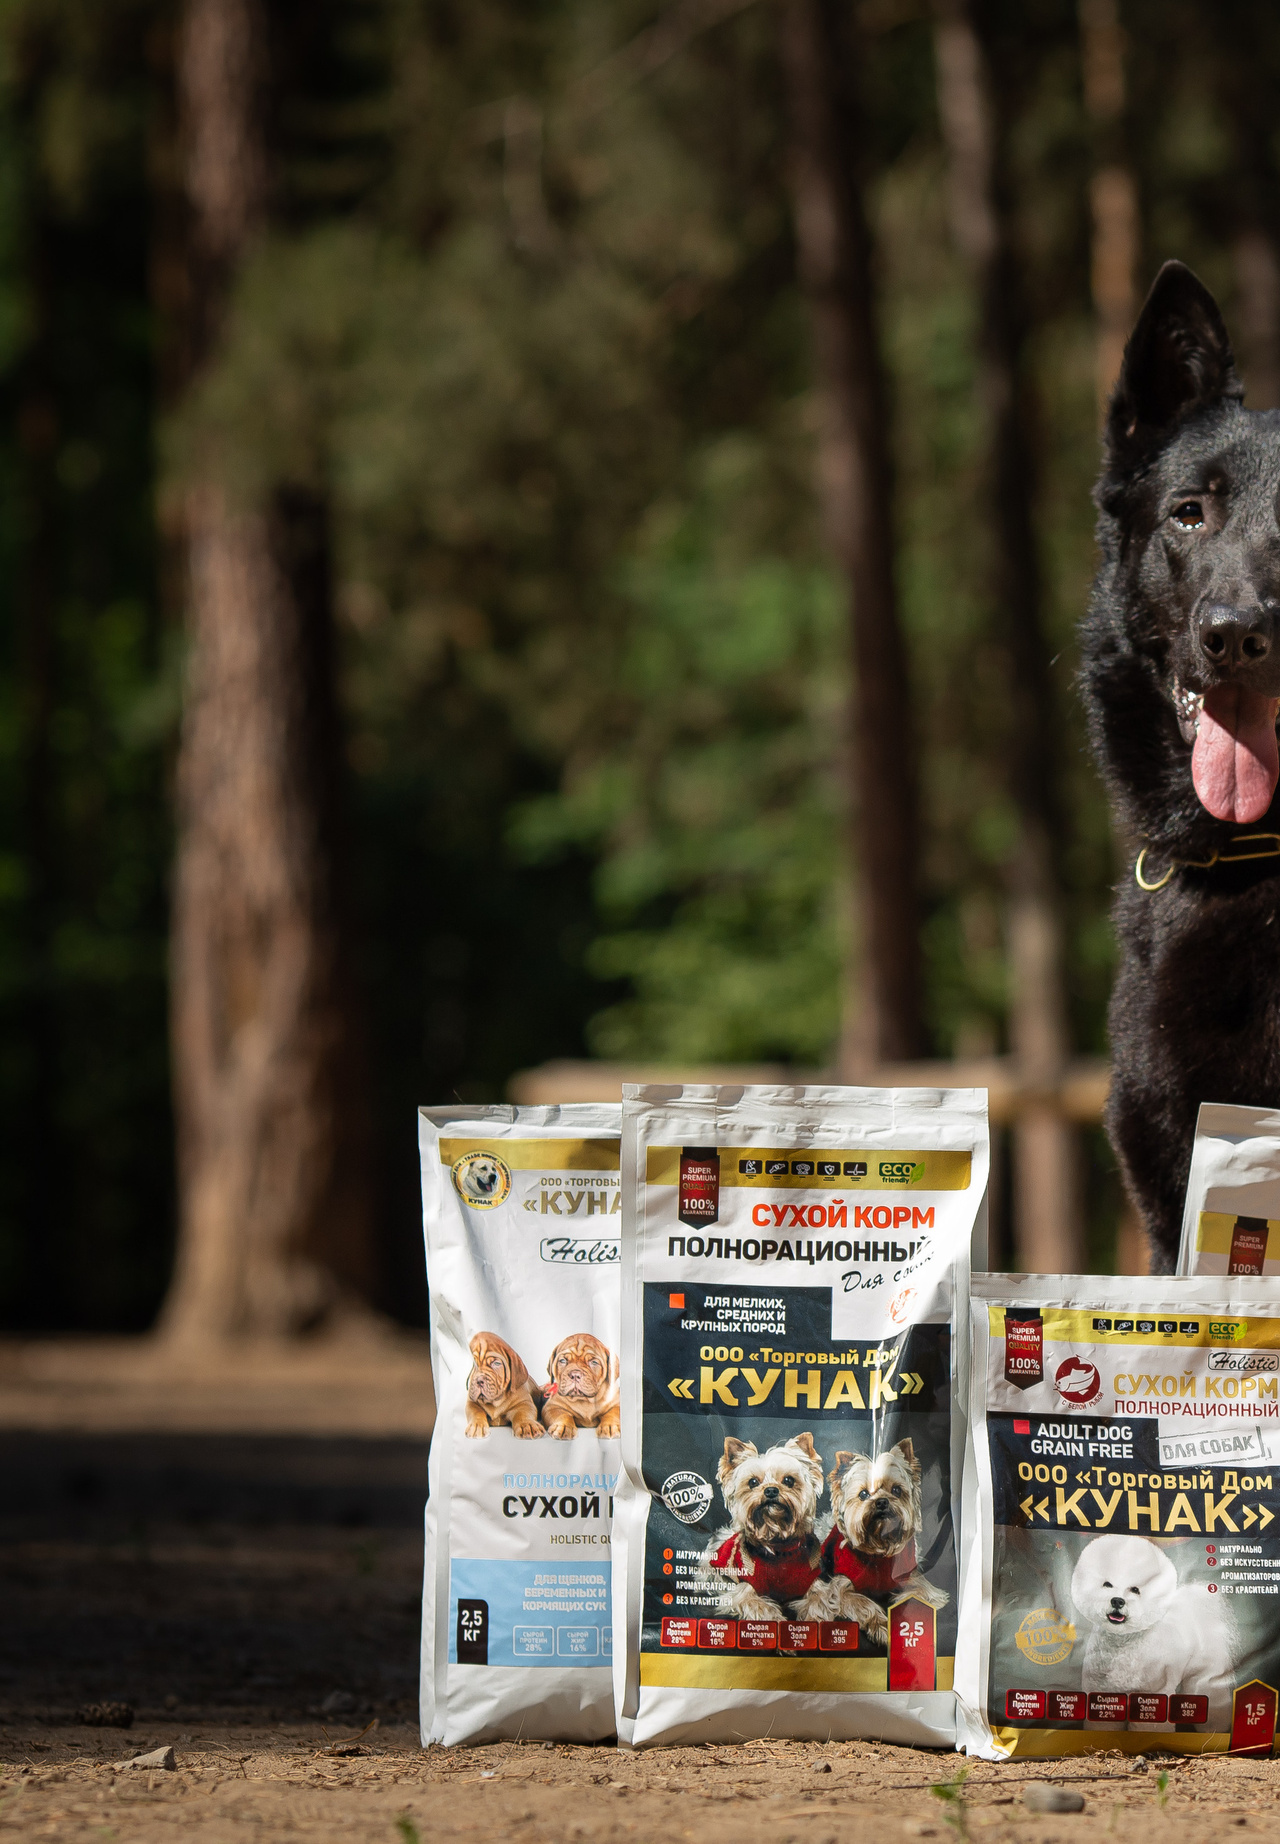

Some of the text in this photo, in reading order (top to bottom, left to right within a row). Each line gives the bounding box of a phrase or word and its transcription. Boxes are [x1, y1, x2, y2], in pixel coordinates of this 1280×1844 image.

[687, 1166, 712, 1174] SUPER
[881, 1164, 913, 1175] eco
[540, 1178, 562, 1187] ООО
[682, 1174, 717, 1182] PREMIUM
[882, 1176, 910, 1185] friendly
[682, 1182, 716, 1191] QUALITY
[468, 1197, 493, 1206] КУНАК
[683, 1198, 715, 1210] 100%
[752, 1199, 936, 1229] СУХОЙ КОРМ
[1239, 1235, 1260, 1243] SUPER
[547, 1238, 621, 1262] Holis
[1234, 1241, 1264, 1250] PREMIUM
[1232, 1263, 1259, 1275] 100%
[841, 1270, 884, 1293] Для
[704, 1295, 786, 1311] ДЛЯ МЕЛКИХ,
[716, 1309, 786, 1322] СРЕДНИХ И
[681, 1319, 786, 1335] КРУПНЫХ ПОРОД
[1012, 1327, 1035, 1335] SUPER
[1211, 1323, 1237, 1334] eco
[1007, 1333, 1040, 1342] PREMIUM
[1008, 1341, 1040, 1351] QUALITY
[700, 1345, 899, 1368] ООО «Торговый Дом
[1212, 1351, 1277, 1371] Holistic
[1009, 1357, 1040, 1370] 100%
[667, 1366, 925, 1410] «КУНАК»
[1113, 1370, 1278, 1399] СУХОЙ КОРМ
[1114, 1400, 1280, 1419] ПОЛНОРАЦИОННЫЙ
[1037, 1423, 1133, 1441] ADULT DOG
[1030, 1439, 1134, 1459] GRAIN FREE
[1162, 1434, 1255, 1460] ДЛЯ СОБАК
[666, 1474, 696, 1488] NATURAL
[1018, 1462, 1273, 1495] ООО «Торговый Дом
[667, 1486, 704, 1507] 100%
[502, 1491, 600, 1518] СУХОЙ
[1019, 1486, 1276, 1533] «КУНАК»
[550, 1535, 597, 1544] HOLISTIC
[1219, 1545, 1263, 1553] НАТУРАЛЬНО
[1220, 1558, 1233, 1566] БЕЗ
[675, 1565, 687, 1575] БЕЗ
[534, 1574, 606, 1587] ДЛЯ ЩЕНКОВ,
[1220, 1572, 1280, 1581] АРОМАТИЗАТОРОВ
[675, 1580, 736, 1591] АРОМАТИЗАТОРОВ
[1221, 1585, 1233, 1594] БЕЗ
[1235, 1584, 1279, 1594] КРАСИТЕЛЕЙ
[524, 1587, 606, 1598] БЕРЕМЕННЫХ И
[676, 1595, 733, 1607] БЕЗ КРАСИТЕЛЕЙ
[522, 1601, 606, 1613] КОРМЯЩИХ СУК
[461, 1609, 483, 1628] 2,5
[669, 1620, 690, 1629] Сырой
[707, 1622, 728, 1631] Сырой
[747, 1623, 769, 1632] Сырая
[788, 1625, 810, 1633] Сырая
[899, 1621, 924, 1638] 2,5
[666, 1628, 691, 1637] Протеин
[710, 1631, 725, 1639] Жир
[740, 1631, 775, 1639] Клетчатка
[790, 1632, 807, 1640] Зола
[1024, 1626, 1067, 1646] 100%
[793, 1639, 804, 1647] 7%
[833, 1636, 846, 1644] 395
[525, 1643, 542, 1651] 28%
[570, 1643, 587, 1651] 16%
[1015, 1692, 1037, 1701] Сырой
[1056, 1694, 1078, 1703] Сырой
[1097, 1695, 1119, 1703] Сырая
[1137, 1696, 1159, 1705] Сырая
[1012, 1701, 1040, 1709] Протеин
[1059, 1702, 1074, 1710] Жир
[1090, 1703, 1124, 1711] Клетчатка
[1182, 1709, 1194, 1717] 382
[1245, 1703, 1266, 1718] 1,5
